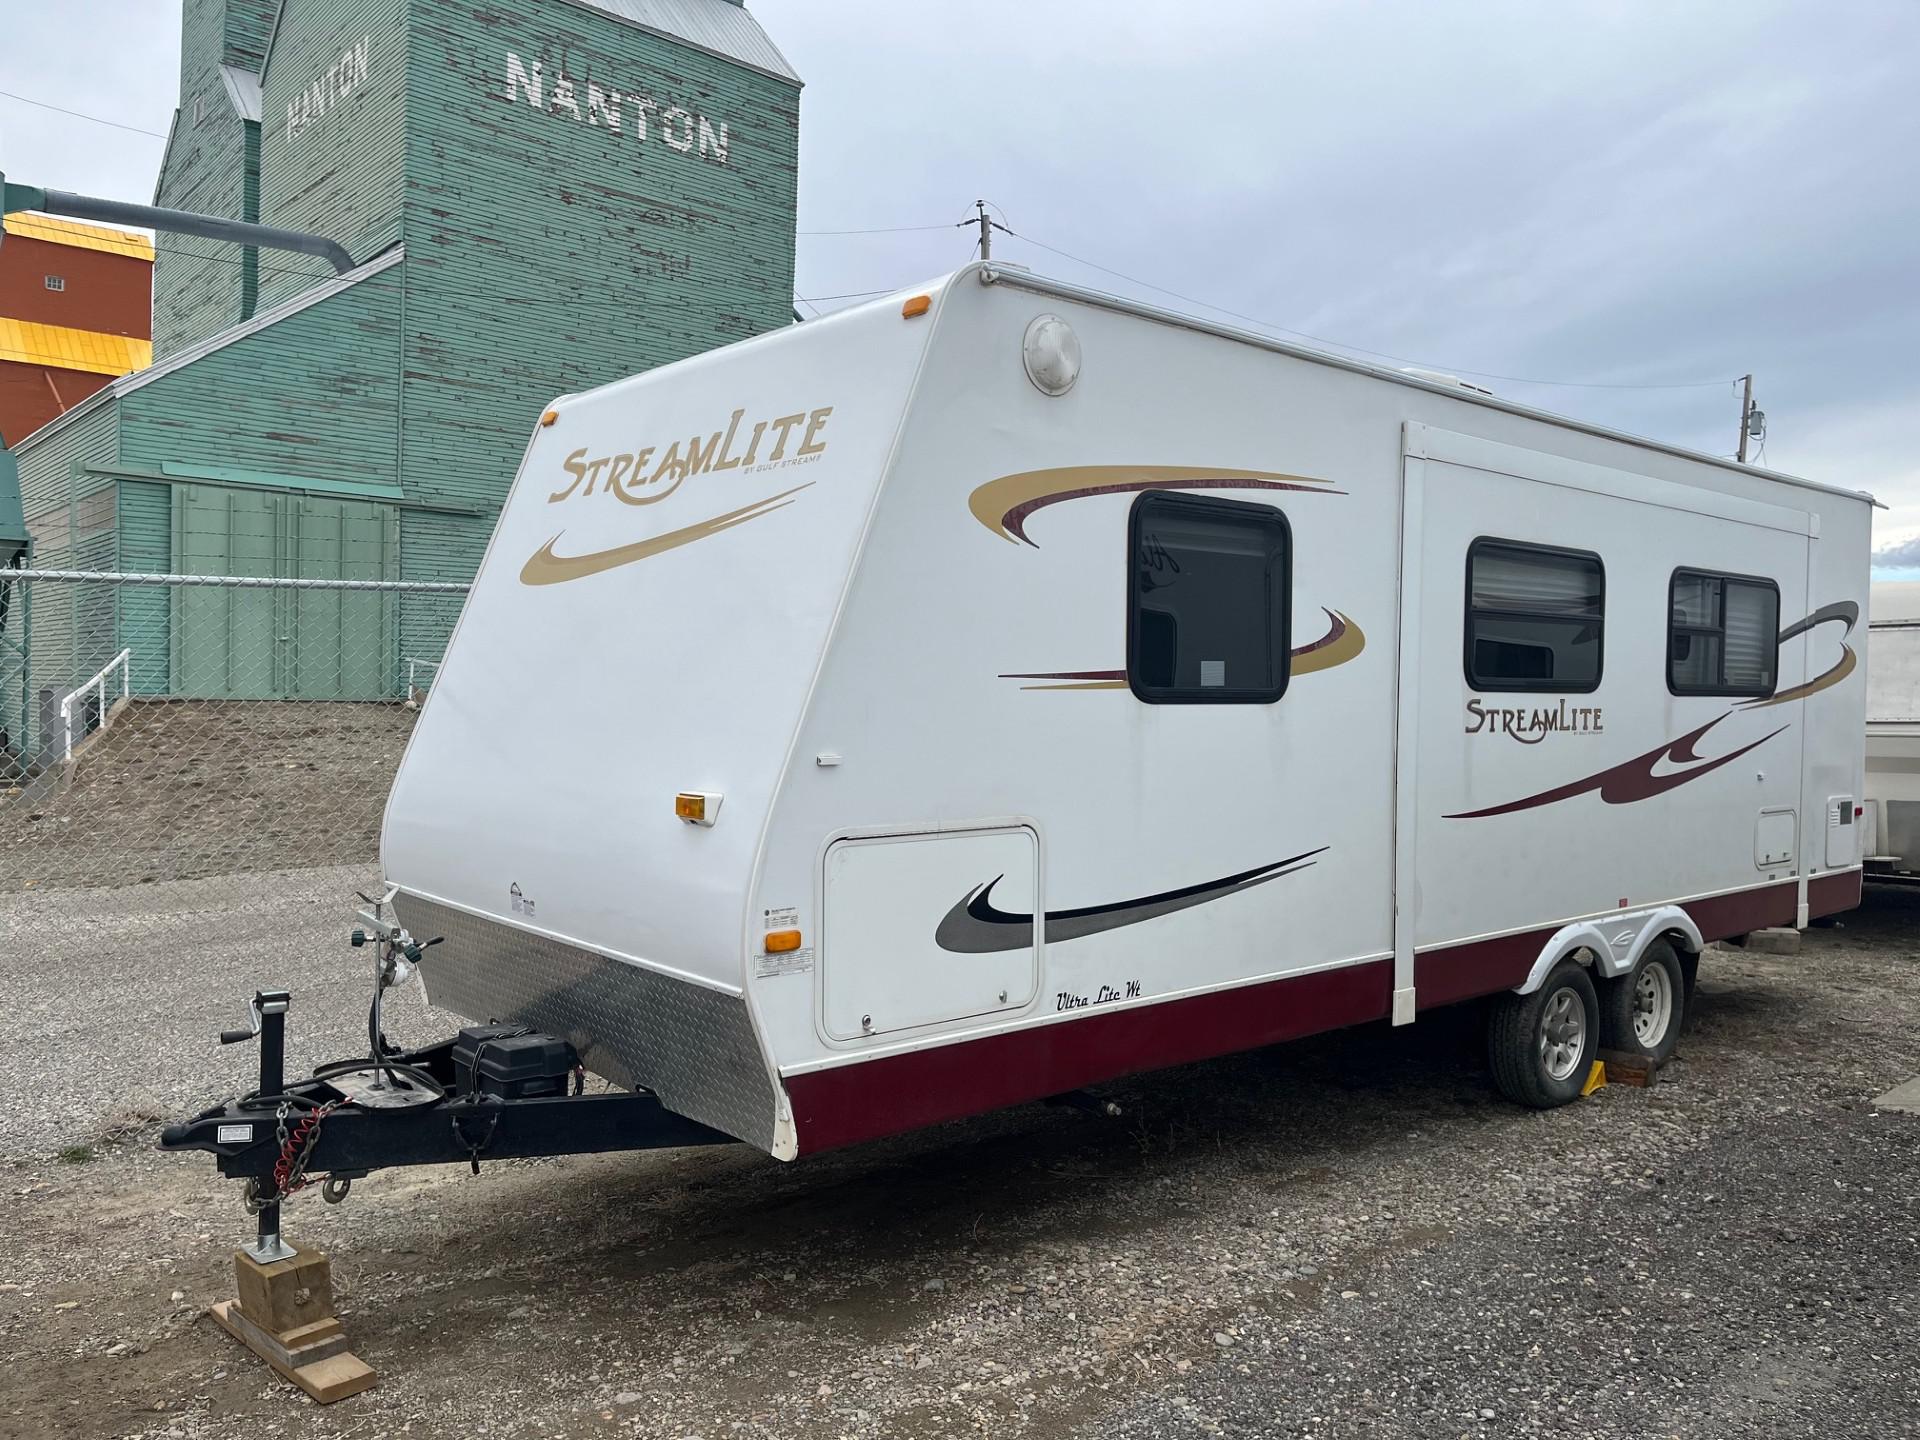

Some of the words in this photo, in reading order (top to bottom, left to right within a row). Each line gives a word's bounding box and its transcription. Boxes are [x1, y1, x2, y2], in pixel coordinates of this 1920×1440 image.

[287, 36, 369, 140] NANTON
[505, 51, 729, 164] NANTON
[1056, 992, 1088, 1011] Ultra
[1093, 985, 1120, 1004] Lite
